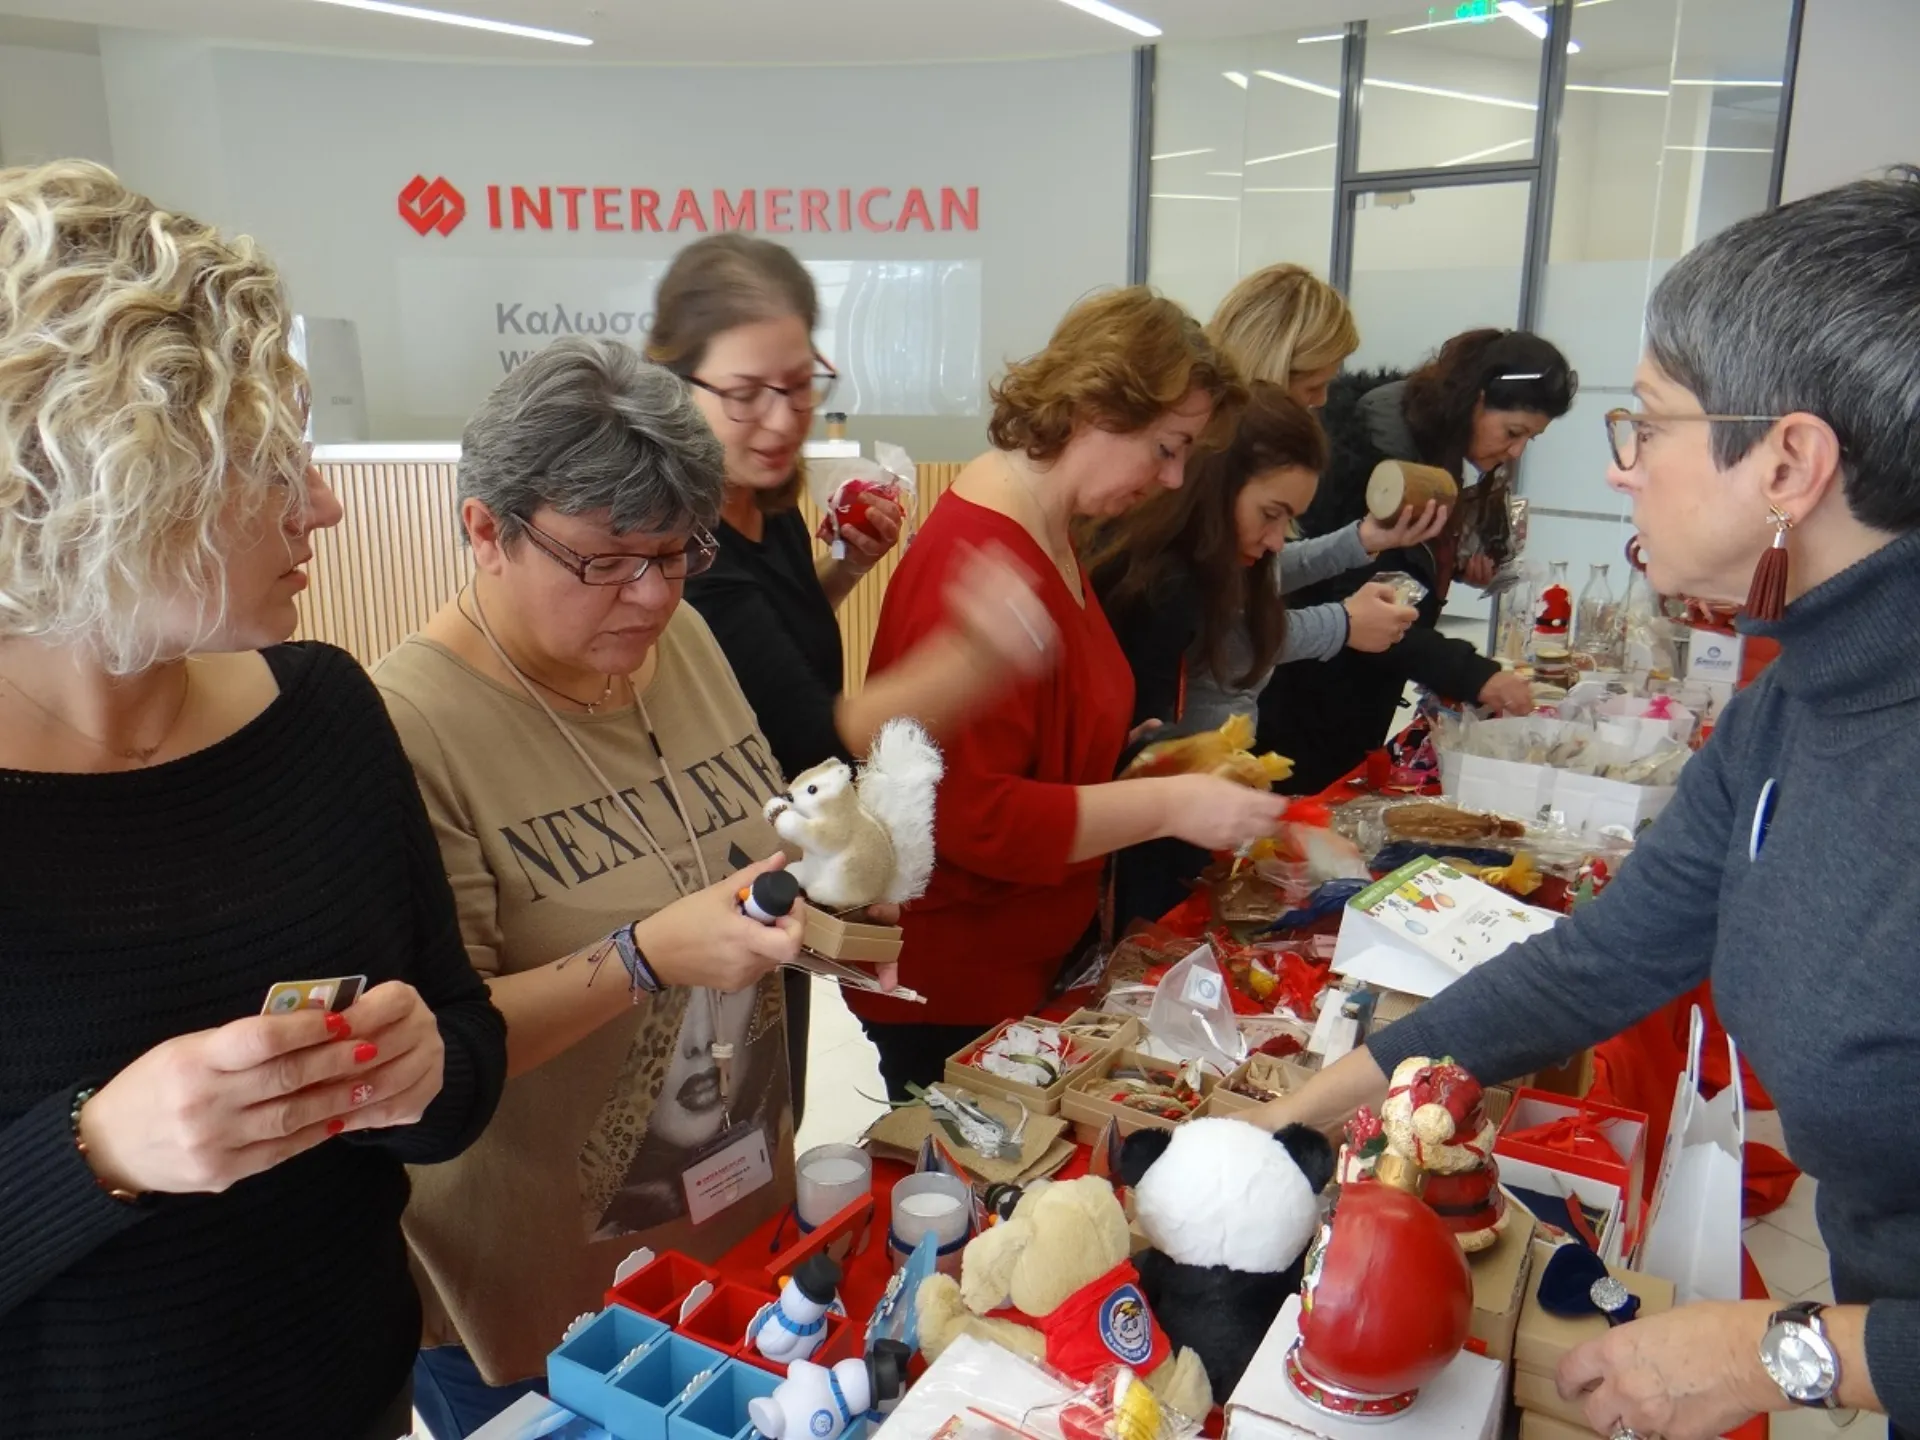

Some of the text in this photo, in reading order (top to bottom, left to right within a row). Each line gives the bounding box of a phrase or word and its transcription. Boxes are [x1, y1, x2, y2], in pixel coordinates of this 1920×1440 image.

[487, 185, 979, 232] INTERAMERICAN
[496, 303, 656, 335] Καλωσο
[498, 733, 786, 902] NEXT LEVE
